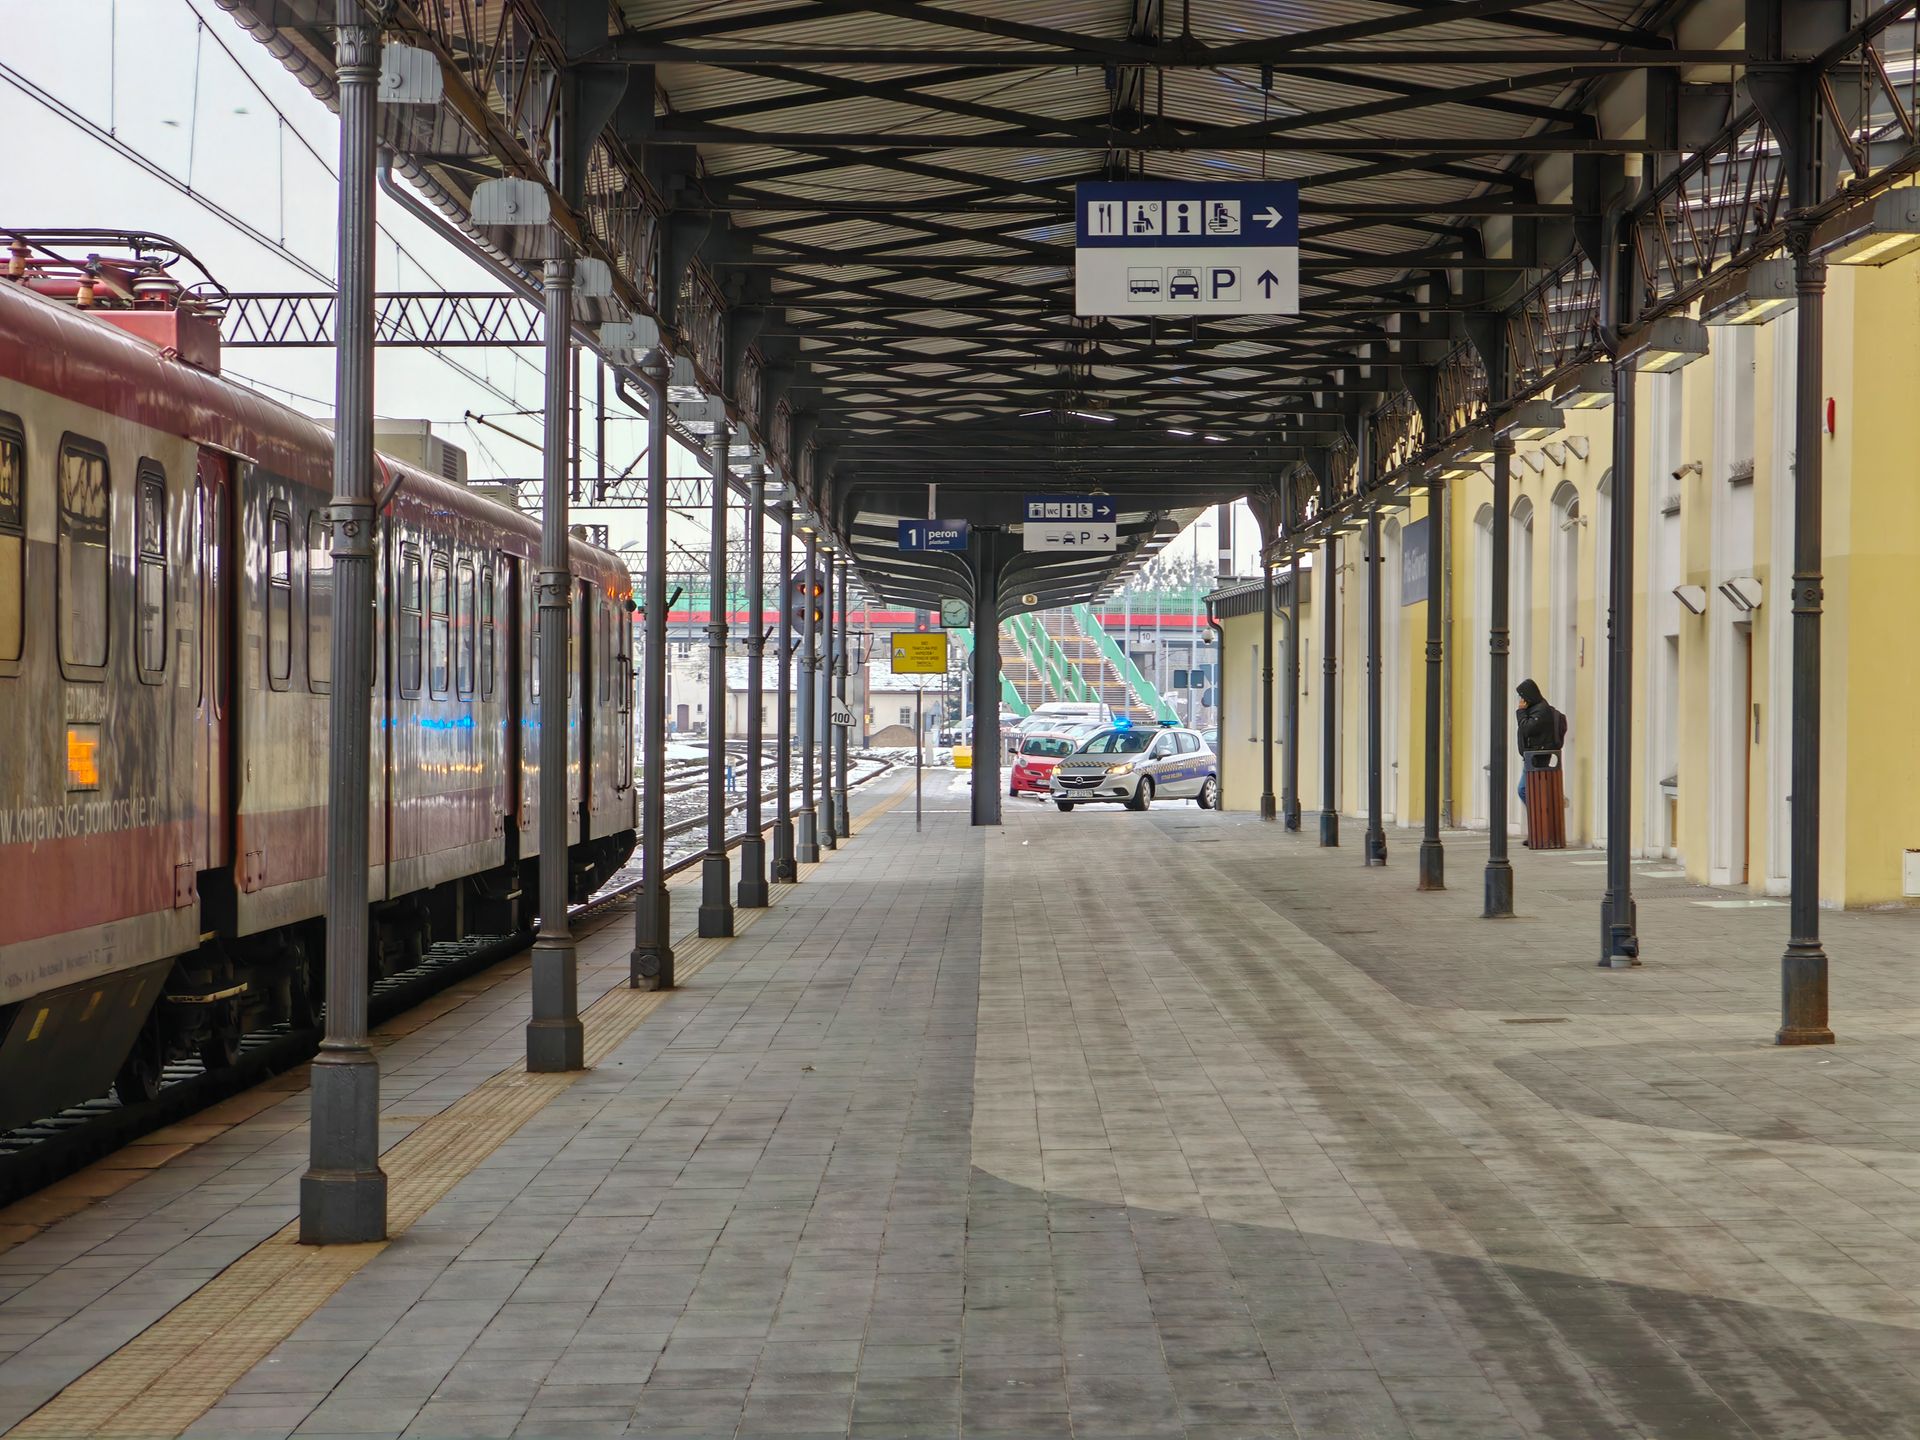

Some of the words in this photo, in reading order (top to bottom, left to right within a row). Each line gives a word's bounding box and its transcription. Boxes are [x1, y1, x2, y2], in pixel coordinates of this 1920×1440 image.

[1212, 269, 1236, 299] P
[908, 528, 917, 546] 1
[928, 530, 958, 540] peron
[1080, 531, 1091, 545] P
[1142, 632, 1151, 641] 10
[831, 712, 850, 723] 100
